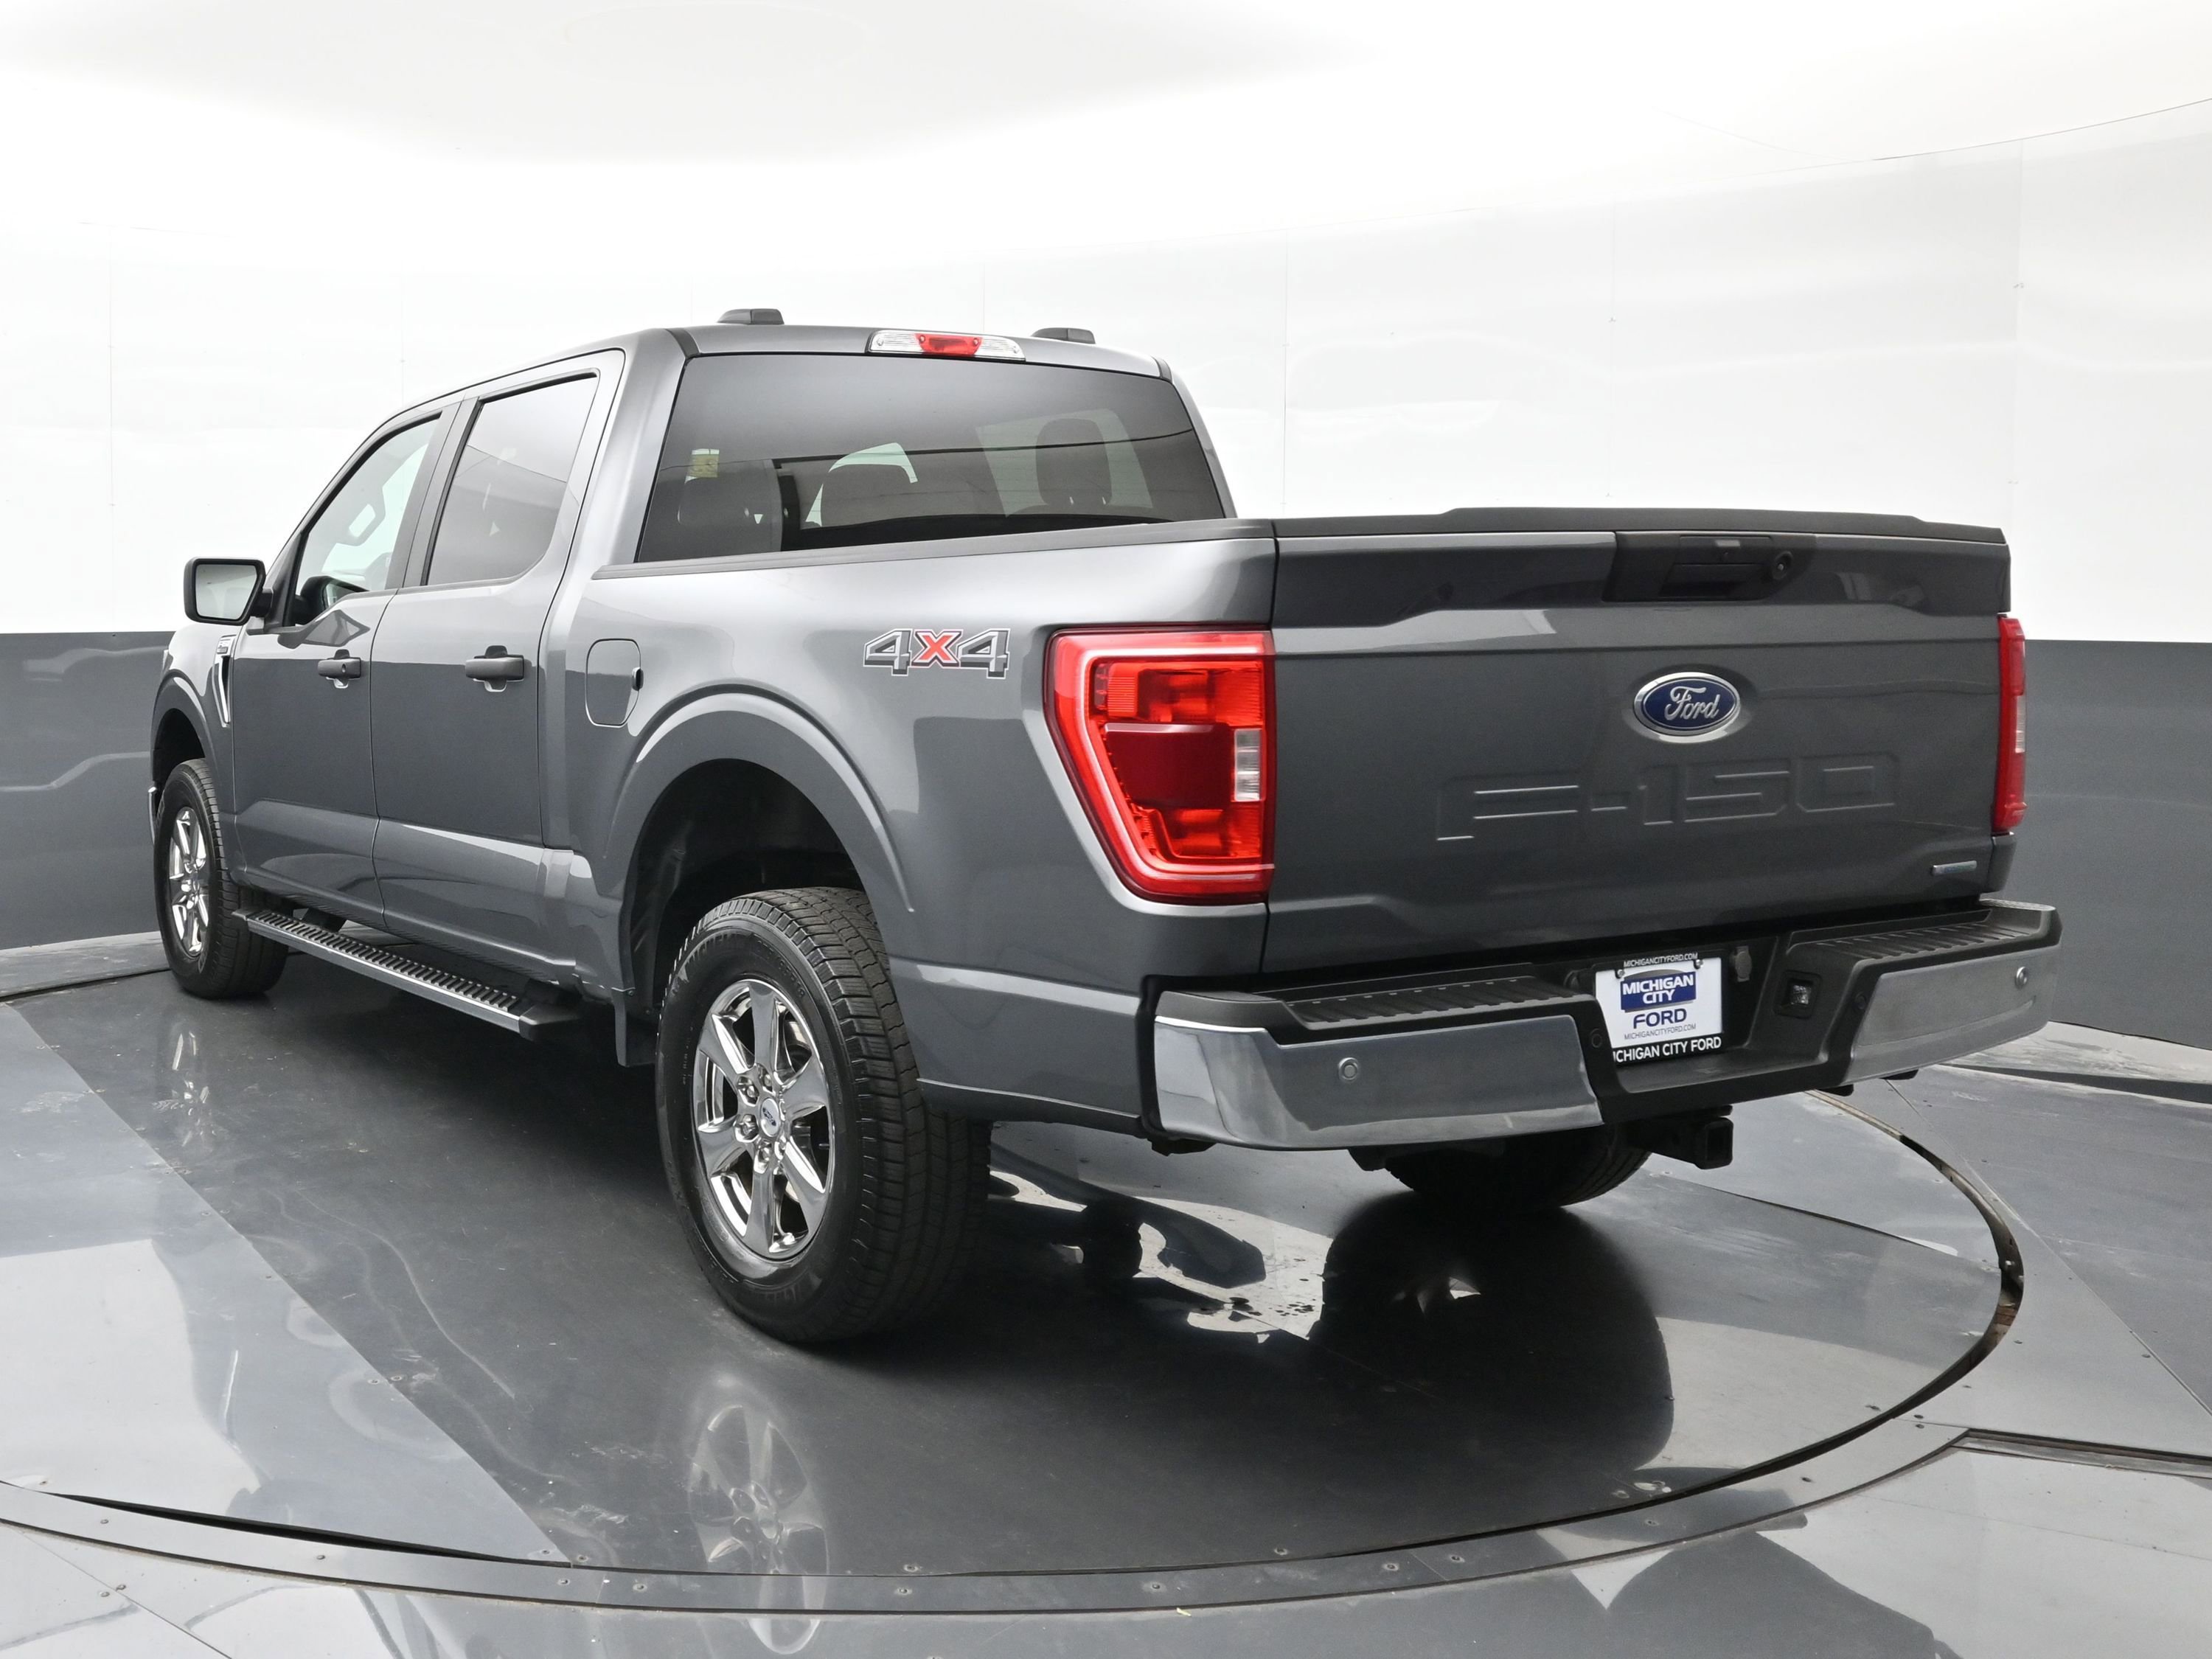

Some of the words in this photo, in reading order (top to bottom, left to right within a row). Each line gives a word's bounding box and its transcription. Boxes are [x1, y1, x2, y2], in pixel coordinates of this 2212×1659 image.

[863, 628, 1011, 679] 4X4
[1664, 686, 1721, 720] Ford
[1437, 752, 1899, 841] F-150
[1624, 953, 1698, 967] MICHIGANCITYFORD.COM
[1622, 975, 1694, 995] MICHIGAN
[1642, 990, 1675, 1004] CITY
[1633, 1008, 1687, 1029] FORD
[1624, 1023, 1696, 1040] MICHIGANCITYFORD.COM
[1613, 1044, 1660, 1062] ICHIGAN
[1662, 1040, 1688, 1056] CITY
[1691, 1036, 1722, 1051] FORD
